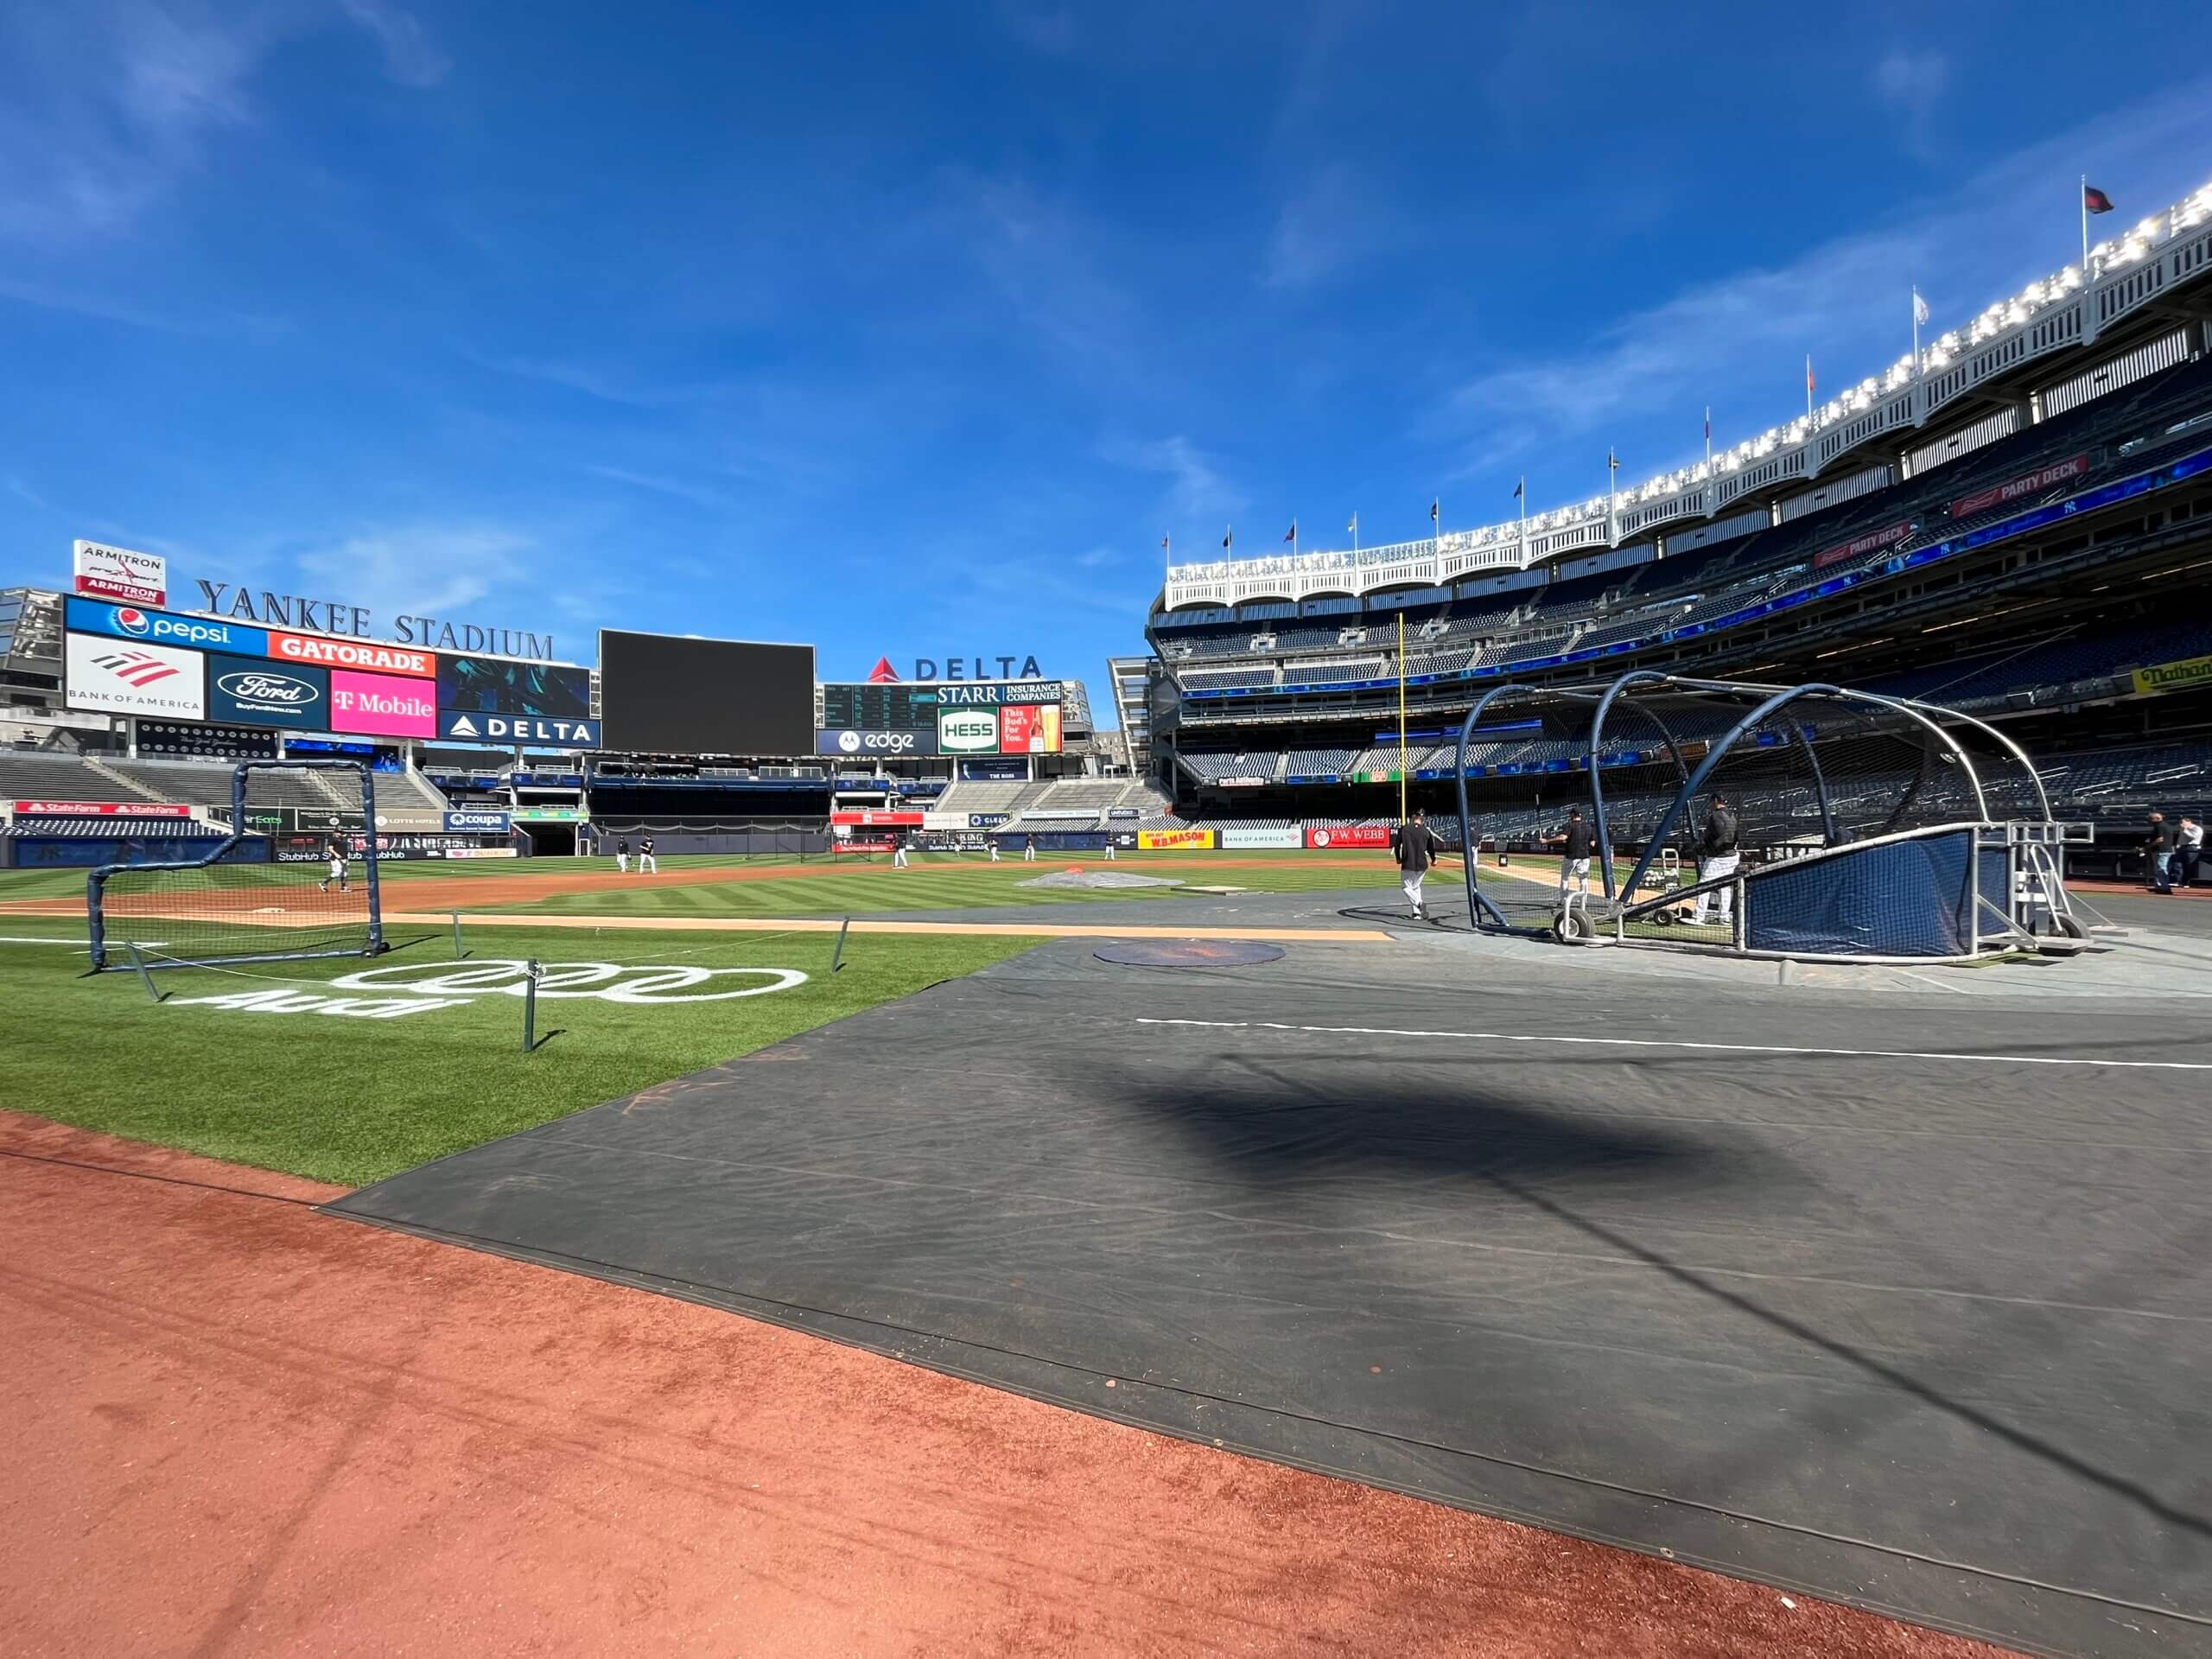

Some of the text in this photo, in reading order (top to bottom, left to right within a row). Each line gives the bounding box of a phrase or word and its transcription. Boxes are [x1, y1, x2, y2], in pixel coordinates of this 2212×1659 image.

[1999, 461, 2079, 499] PARTY DECK
[1849, 536, 1878, 555] PARTY
[1878, 526, 1904, 544] DECK
[84, 547, 161, 569] ARMITRON
[88, 579, 157, 598] ARMITRON
[194, 579, 554, 660] YANKEE STADIUM
[281, 638, 425, 671] GATORADE
[916, 656, 1042, 681] DELTA
[68, 690, 200, 709] BANK OF AMERICA
[236, 676, 302, 701] Ford
[938, 686, 1000, 703] STARR
[1007, 683, 1061, 694] INSURANCE
[1007, 691, 1061, 702] COMPANIES
[359, 694, 432, 717] Mobile
[488, 718, 591, 741] DELTA
[944, 723, 993, 737] HESS
[865, 731, 914, 753] edge
[466, 815, 502, 825] coupa
[1353, 830, 1385, 839] WEBB
[278, 851, 320, 861] StubHub
